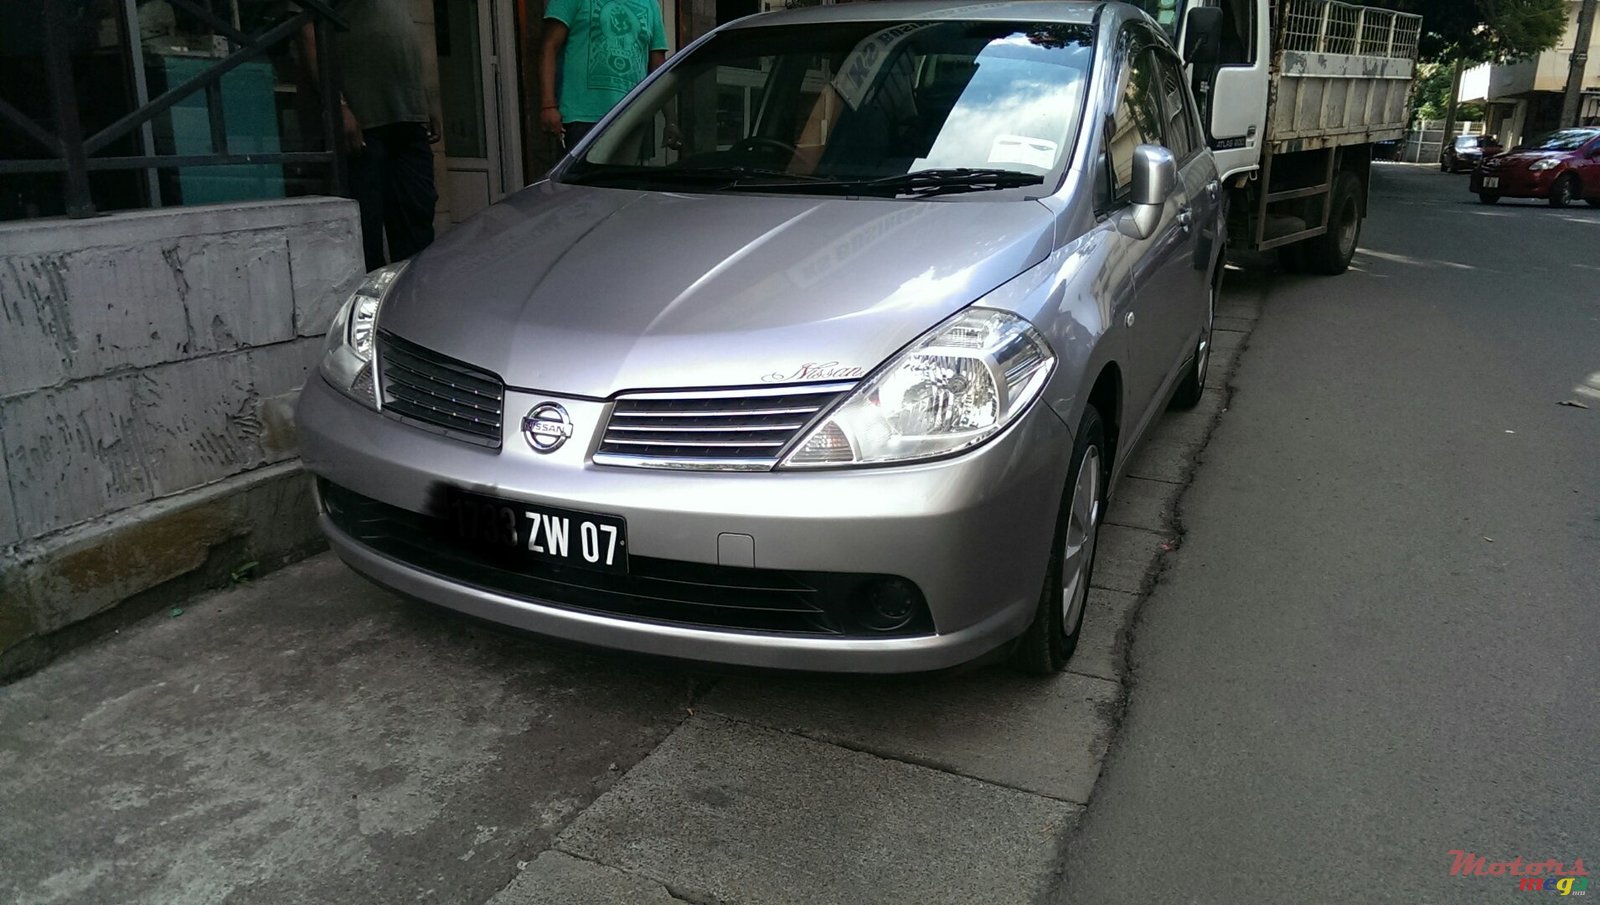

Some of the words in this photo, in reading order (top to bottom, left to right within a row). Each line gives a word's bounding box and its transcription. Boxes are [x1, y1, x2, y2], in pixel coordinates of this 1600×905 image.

[761, 361, 864, 382] Nissan
[525, 421, 565, 434] NISSAN
[525, 511, 569, 557] ZW
[580, 521, 617, 565] 07
